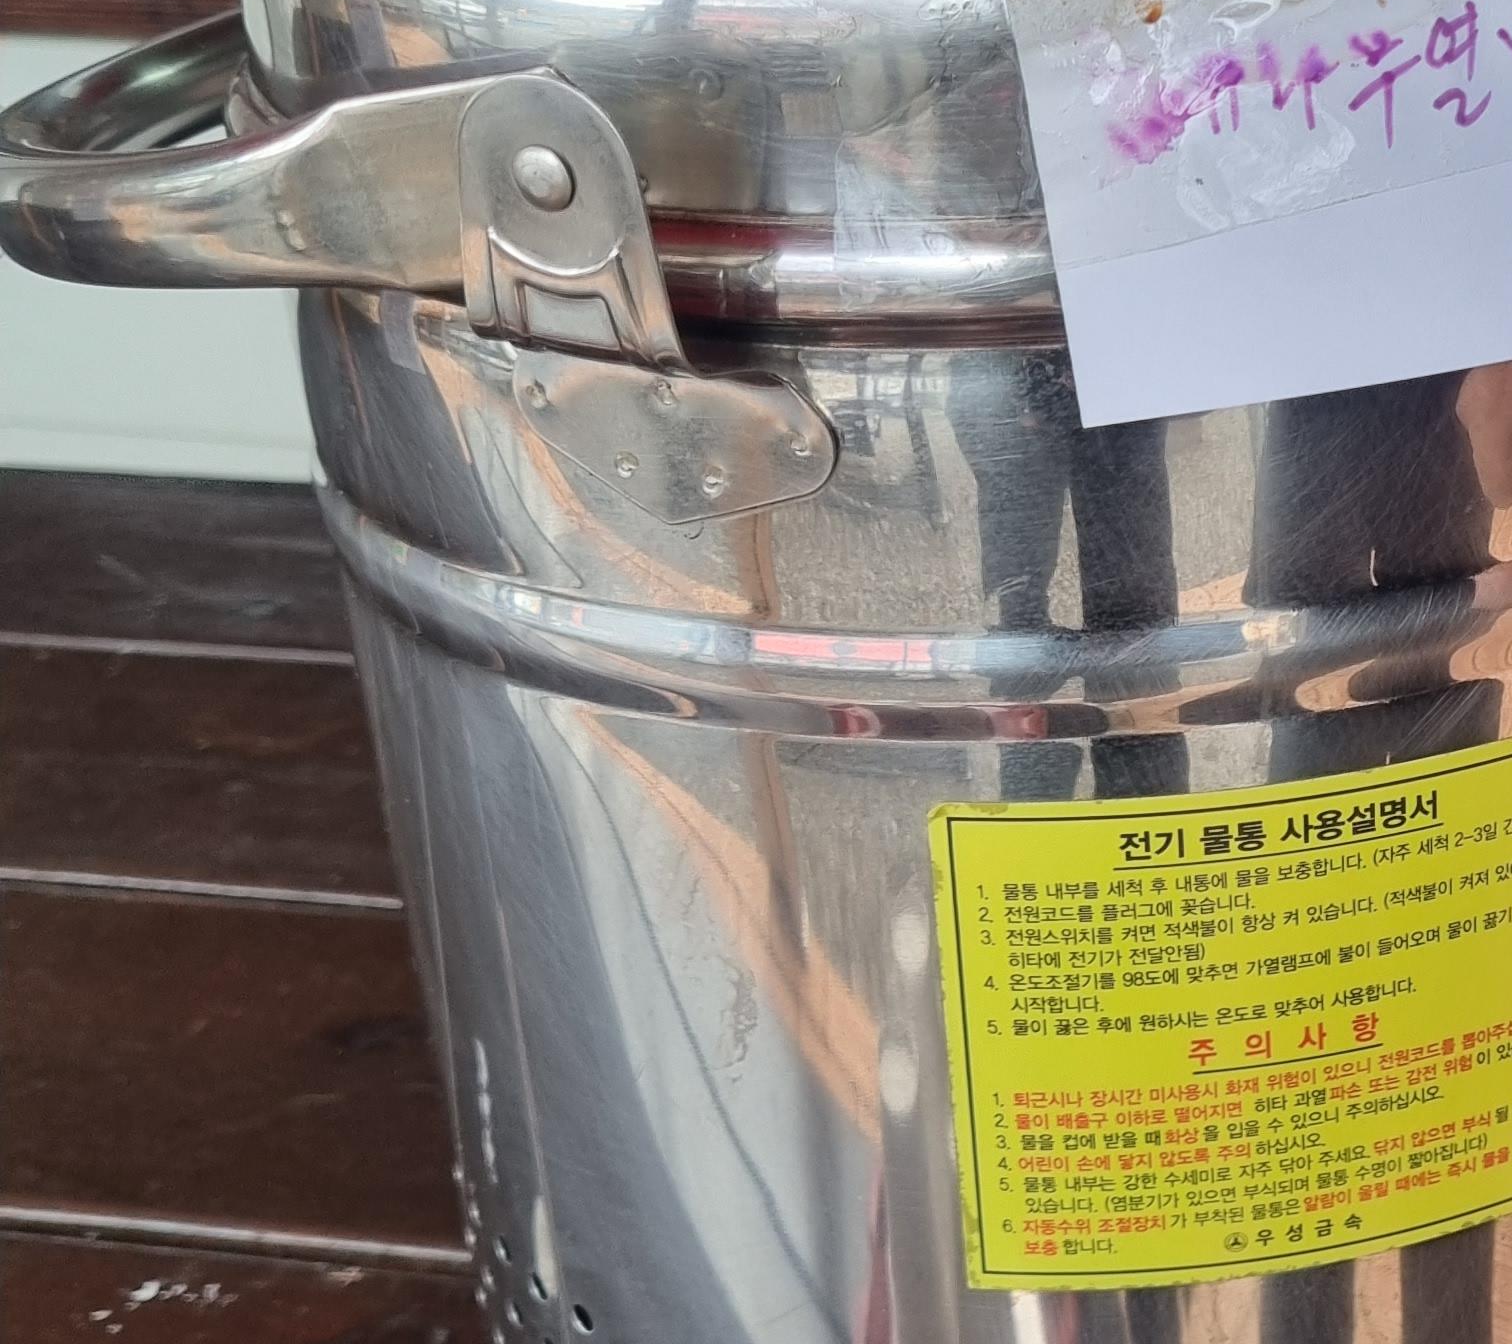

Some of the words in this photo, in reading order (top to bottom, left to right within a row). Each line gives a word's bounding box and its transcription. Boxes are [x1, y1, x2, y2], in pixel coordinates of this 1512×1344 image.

[1119, 828, 1185, 861] 전기
[1199, 819, 1267, 855] 물통
[1280, 790, 1438, 844] 사용설명서
[976, 884, 989, 900] 1.
[1002, 883, 1038, 901] 물통
[1046, 882, 1099, 900] 내부를
[1107, 879, 1142, 897] 세척
[1150, 877, 1167, 895] 후
[1176, 872, 1227, 893] 내통에
[1235, 866, 1270, 888] 물을
[1278, 853, 1366, 882] 보충합니다.
[1374, 844, 1410, 867] (자주
[1417, 834, 1448, 856] 세척
[978, 907, 993, 923] 2.
[1004, 906, 1093, 923] 전원코드를
[1101, 901, 1173, 922] 플러그에
[1180, 893, 1254, 916] 꽂습니다.
[980, 930, 995, 946] 3.
[1006, 928, 1112, 946] 전원스위치를
[1122, 925, 1156, 942] 켜면
[1164, 916, 1233, 939] 적색불이
[1242, 913, 1275, 933] 항상
[1283, 908, 1298, 925] 켜
[1307, 897, 1377, 923] 있습니다.
[1384, 879, 1452, 909] (적색불이
[1460, 868, 1488, 890] 켜져
[984, 976, 999, 990] 4.
[1009, 973, 1116, 991] 온도조절기를
[1122, 968, 1178, 986] 98도에
[1186, 961, 1238, 983] 맞추면
[1246, 950, 1331, 976] 가열램프에
[1338, 941, 1371, 962] 불이
[1378, 926, 1440, 955] 들어오며
[1447, 916, 1477, 940] 물이
[1483, 907, 1512, 929] 끓기
[1009, 952, 1061, 968] 히타에
[1068, 949, 1121, 967] 전기가
[1129, 943, 1205, 966] 전달안됨)
[987, 1020, 1001, 1035] 5.
[1012, 1019, 1048, 1036] 물이
[1055, 1017, 1089, 1035] 끓은
[1097, 1016, 1131, 1034] 후에
[1140, 1010, 1208, 1030] 원하시는
[1215, 1004, 1267, 1024] 온도로
[1275, 995, 1324, 1018] 맞추어
[1332, 976, 1416, 1007] 사용합니다.
[1011, 996, 1104, 1014] 시작합니다.
[992, 1093, 1004, 1107] 1.
[1013, 1091, 1083, 1108] 퇴근시나
[1090, 1089, 1142, 1106] 장시간
[1150, 1082, 1218, 1104] 미사용시
[1226, 1077, 1259, 1096] 화재
[1267, 1067, 1317, 1091] 위험이
[1323, 1058, 1371, 1083] 있으니
[1378, 1037, 1456, 1070] 전원코드를
[994, 1114, 1009, 1128] 2.
[1015, 1112, 1049, 1129] 물이
[1056, 1112, 1108, 1128] 배출구
[1116, 1108, 1166, 1127] 이하로
[1174, 1101, 1242, 1124] 떨어지면
[1254, 1094, 1287, 1114] 히타
[1294, 1088, 1326, 1108] 과열
[1329, 1082, 1362, 1101] 파손
[1369, 1072, 1400, 1094] 또는
[1406, 1063, 1437, 1086] 감전
[996, 1136, 1010, 1150] 3.
[1021, 1134, 1054, 1150] 물을
[1062, 1132, 1096, 1150] 컵에
[1104, 1132, 1137, 1150] 받을
[1146, 1130, 1161, 1146] 때
[1227, 1120, 1260, 1140] 입을
[1268, 1117, 1284, 1134] 수
[1291, 1107, 1340, 1131] 있으니
[998, 1158, 1012, 1171] 4.
[1018, 1156, 1069, 1172] 어린이
[1076, 1154, 1110, 1171] 손에
[1118, 1152, 1152, 1170] 닿지
[1160, 1148, 1211, 1168] 않도록
[1000, 1178, 1013, 1192] 5.
[1024, 1176, 1057, 1194] 물통
[1065, 1173, 1115, 1192] 내부는
[1123, 1173, 1157, 1190] 강한
[1164, 1166, 1231, 1187] 수세미로
[1240, 1162, 1273, 1180] 자주
[1279, 1153, 1312, 1172] 닦아
[1373, 1136, 1405, 1156] 닦지
[1411, 1121, 1456, 1148] 않으면
[1003, 1218, 1016, 1234] 6.
[1023, 1218, 1092, 1236] 자동수위
[1194, 1206, 1244, 1226] 부착된
[1250, 1197, 1300, 1220] 물통은
[1303, 1188, 1351, 1212] 알람이
[1358, 1182, 1389, 1202] 울릴
[1395, 1167, 1440, 1191] 때에는
[1447, 1156, 1476, 1177] 즉시
[1482, 1146, 1510, 1168] 물을
[1025, 1196, 1098, 1214] 있습니다.
[1105, 1195, 1178, 1213] (염분기가
[1187, 1186, 1236, 1207] 있으면
[1243, 1175, 1309, 1199] 부식되며
[1316, 1168, 1348, 1189] 물통
[1355, 1158, 1401, 1181] 수명이
[1408, 1133, 1488, 1169] 짧아집니다)
